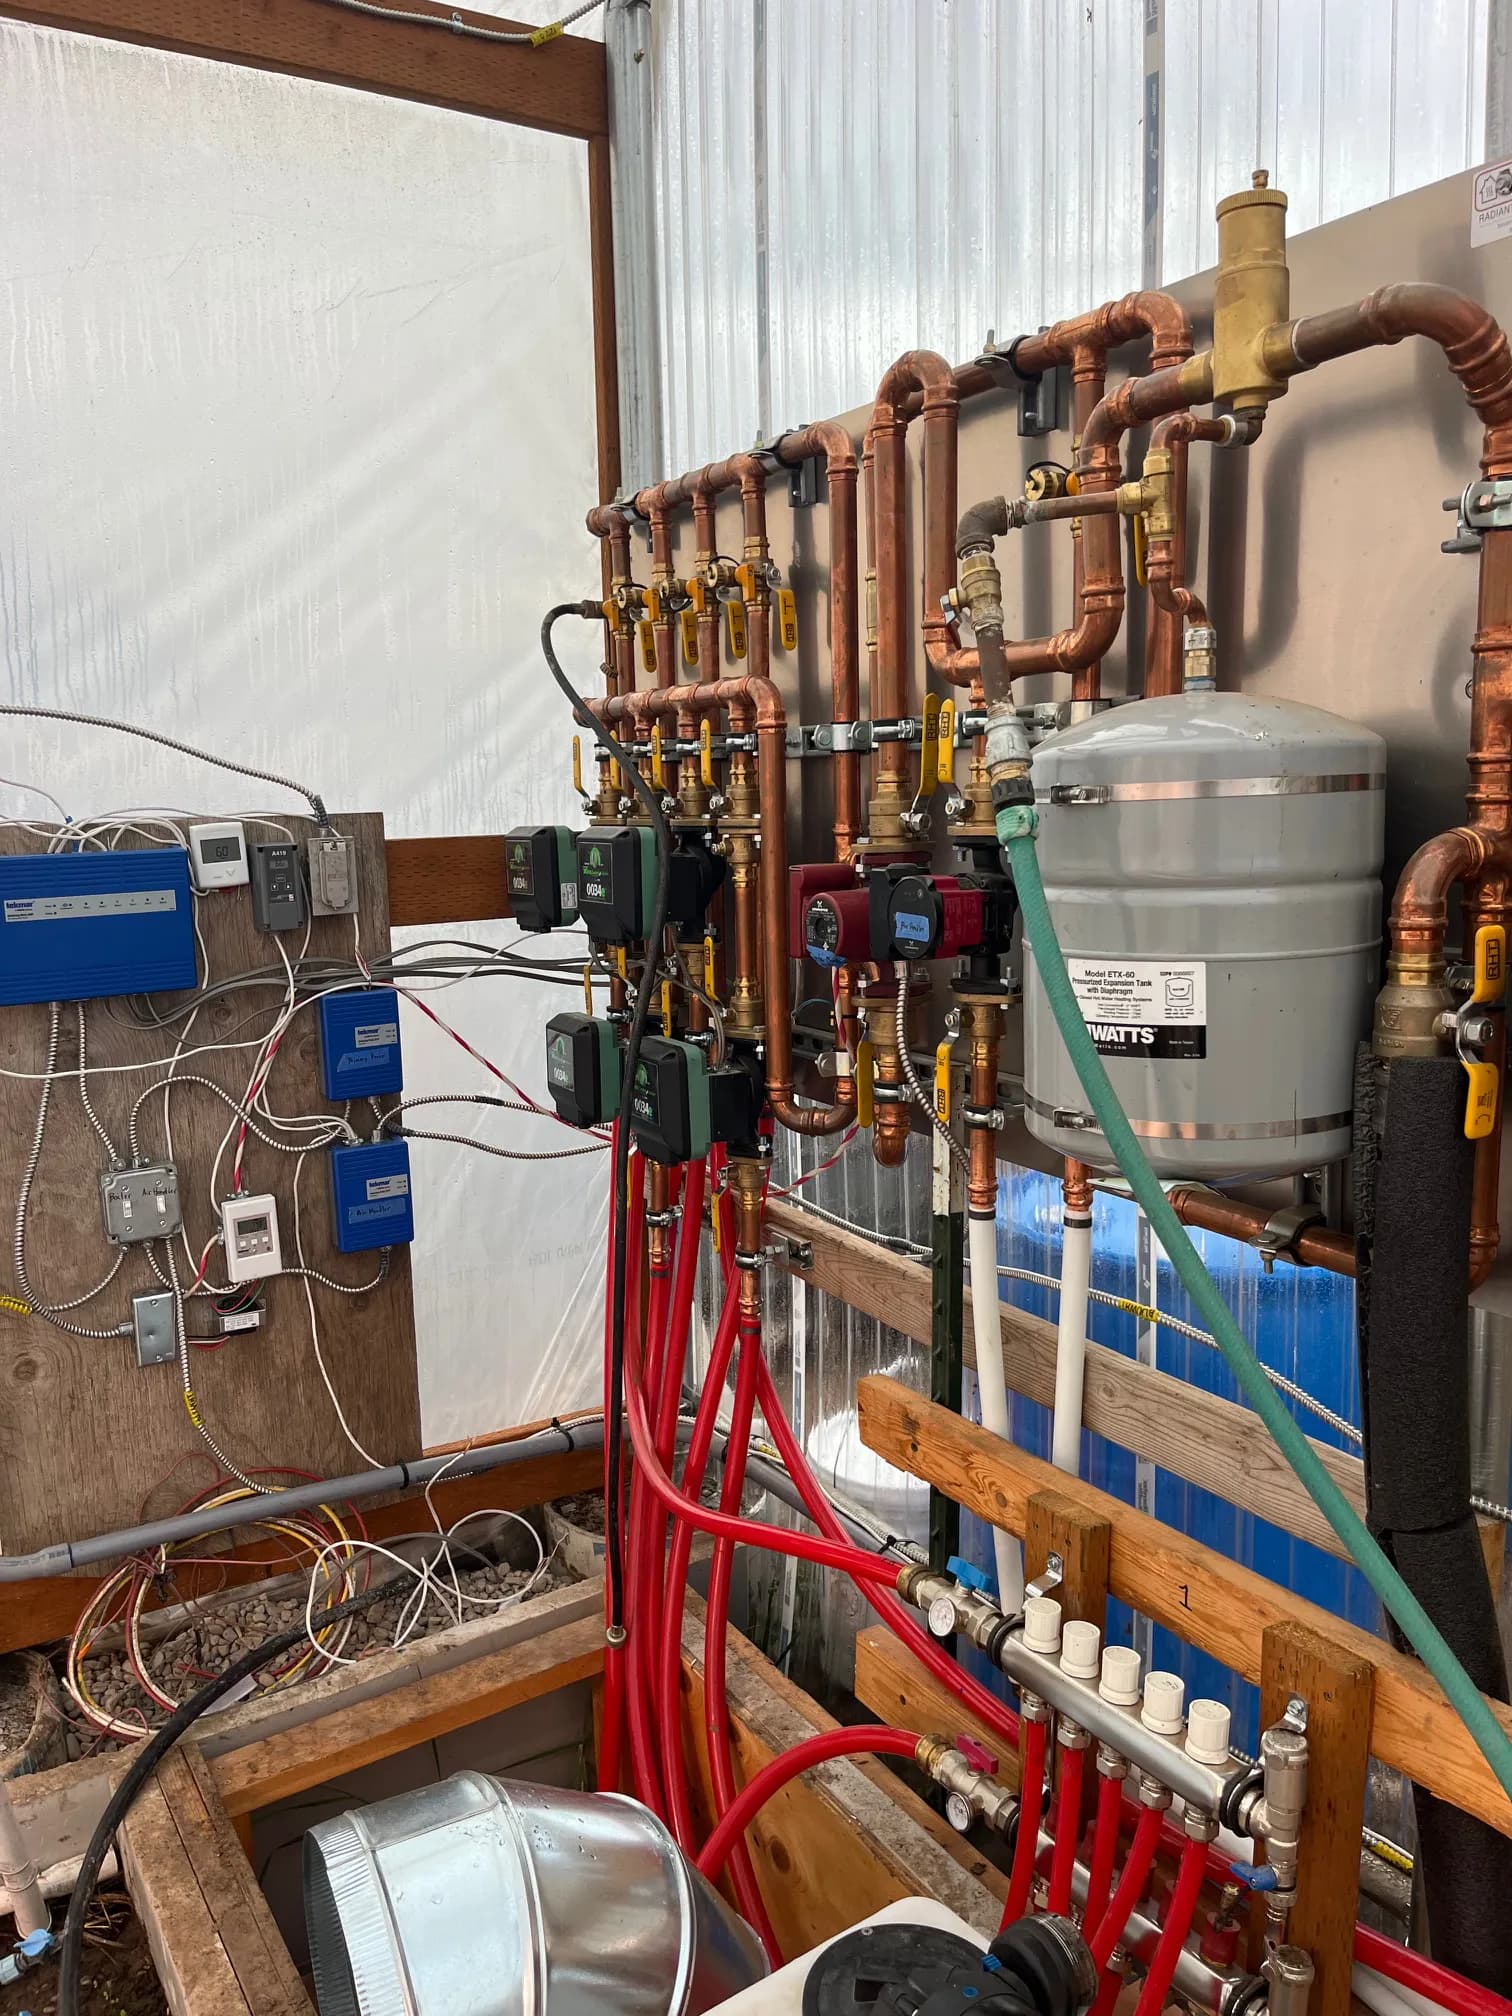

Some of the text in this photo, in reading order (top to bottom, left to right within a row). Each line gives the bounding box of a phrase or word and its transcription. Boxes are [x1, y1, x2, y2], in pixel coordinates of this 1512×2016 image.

[215, 846, 229, 857] 60
[1487, 940, 1499, 979] RHT
[1084, 970, 1135, 979] Model ETX-60
[1103, 979, 1134, 987] Expansion
[1100, 987, 1133, 996] Diaphragm
[1178, 1584, 1193, 1612] 1
